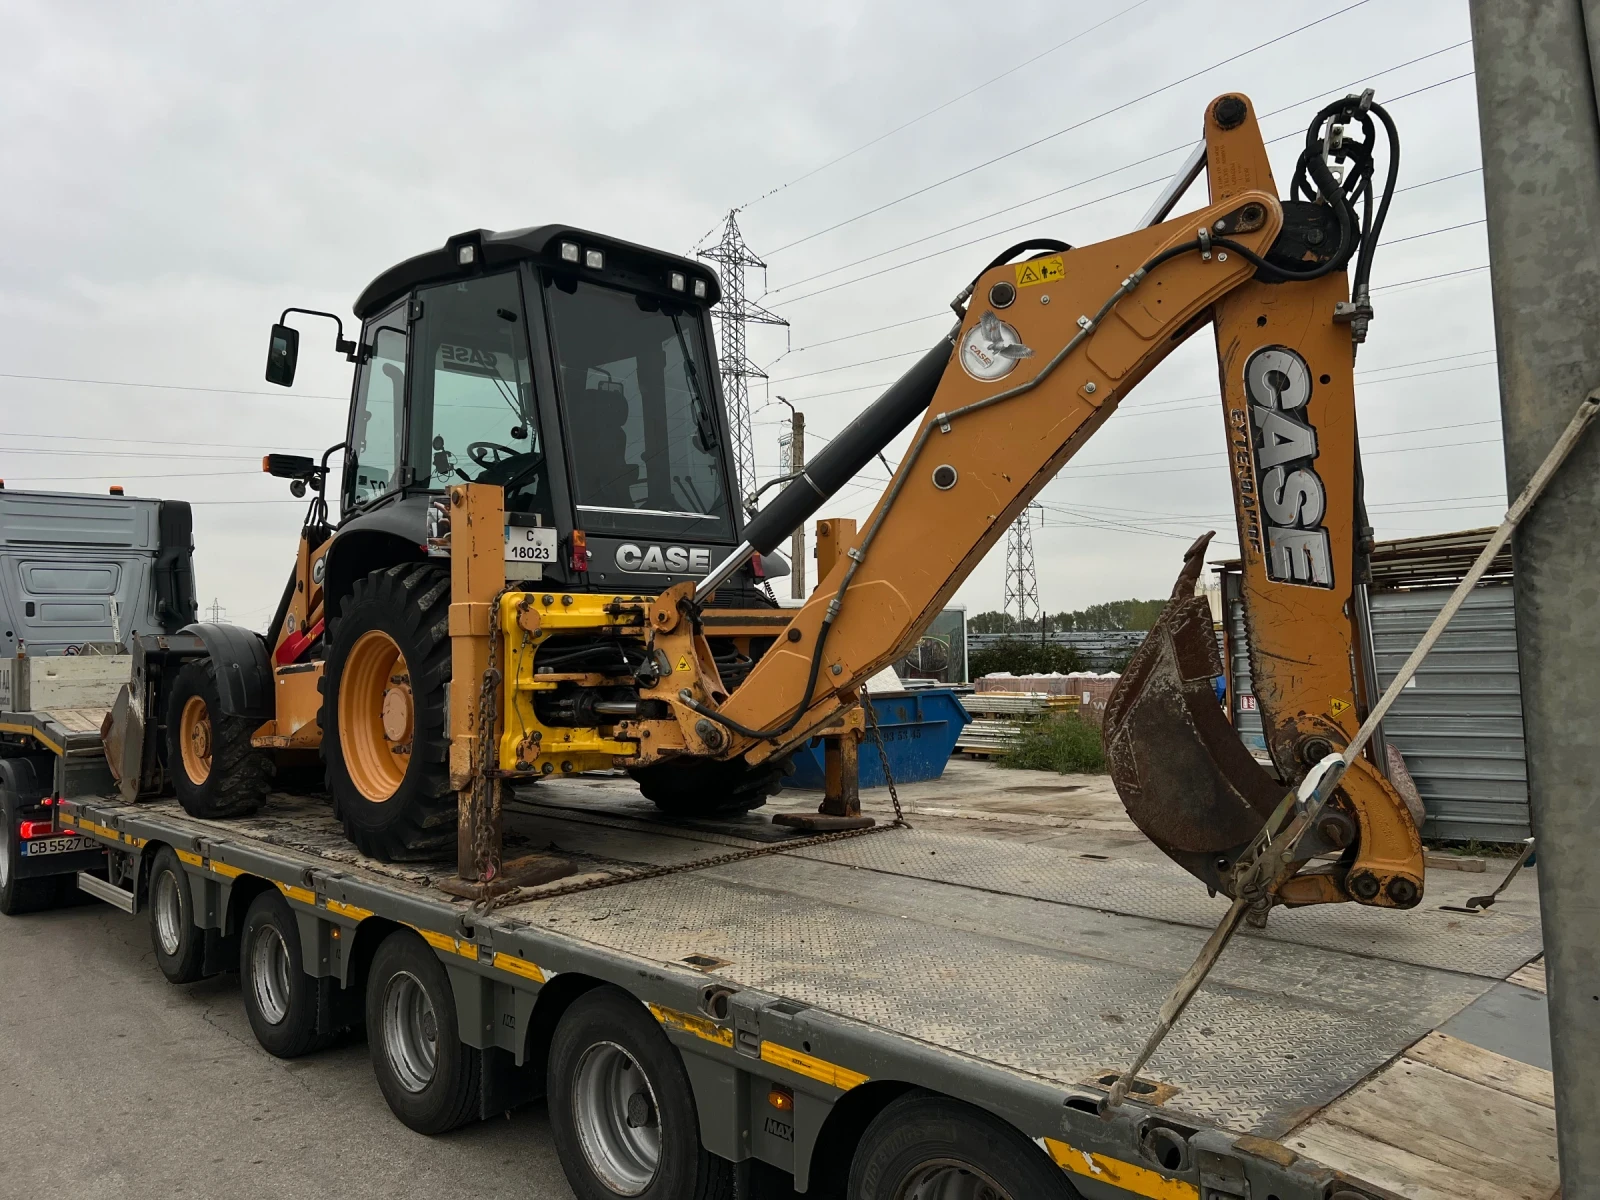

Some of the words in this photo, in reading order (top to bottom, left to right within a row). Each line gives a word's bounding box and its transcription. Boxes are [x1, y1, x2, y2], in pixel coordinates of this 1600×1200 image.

[970, 345, 991, 365] CASE
[1246, 346, 1332, 587] CASE
[526, 530, 535, 542] C
[511, 547, 550, 560] 18023
[616, 543, 711, 573] CASE
[30, 842, 47, 854] CB
[49, 838, 82, 852] 5527
[767, 1117, 794, 1142] MAX
